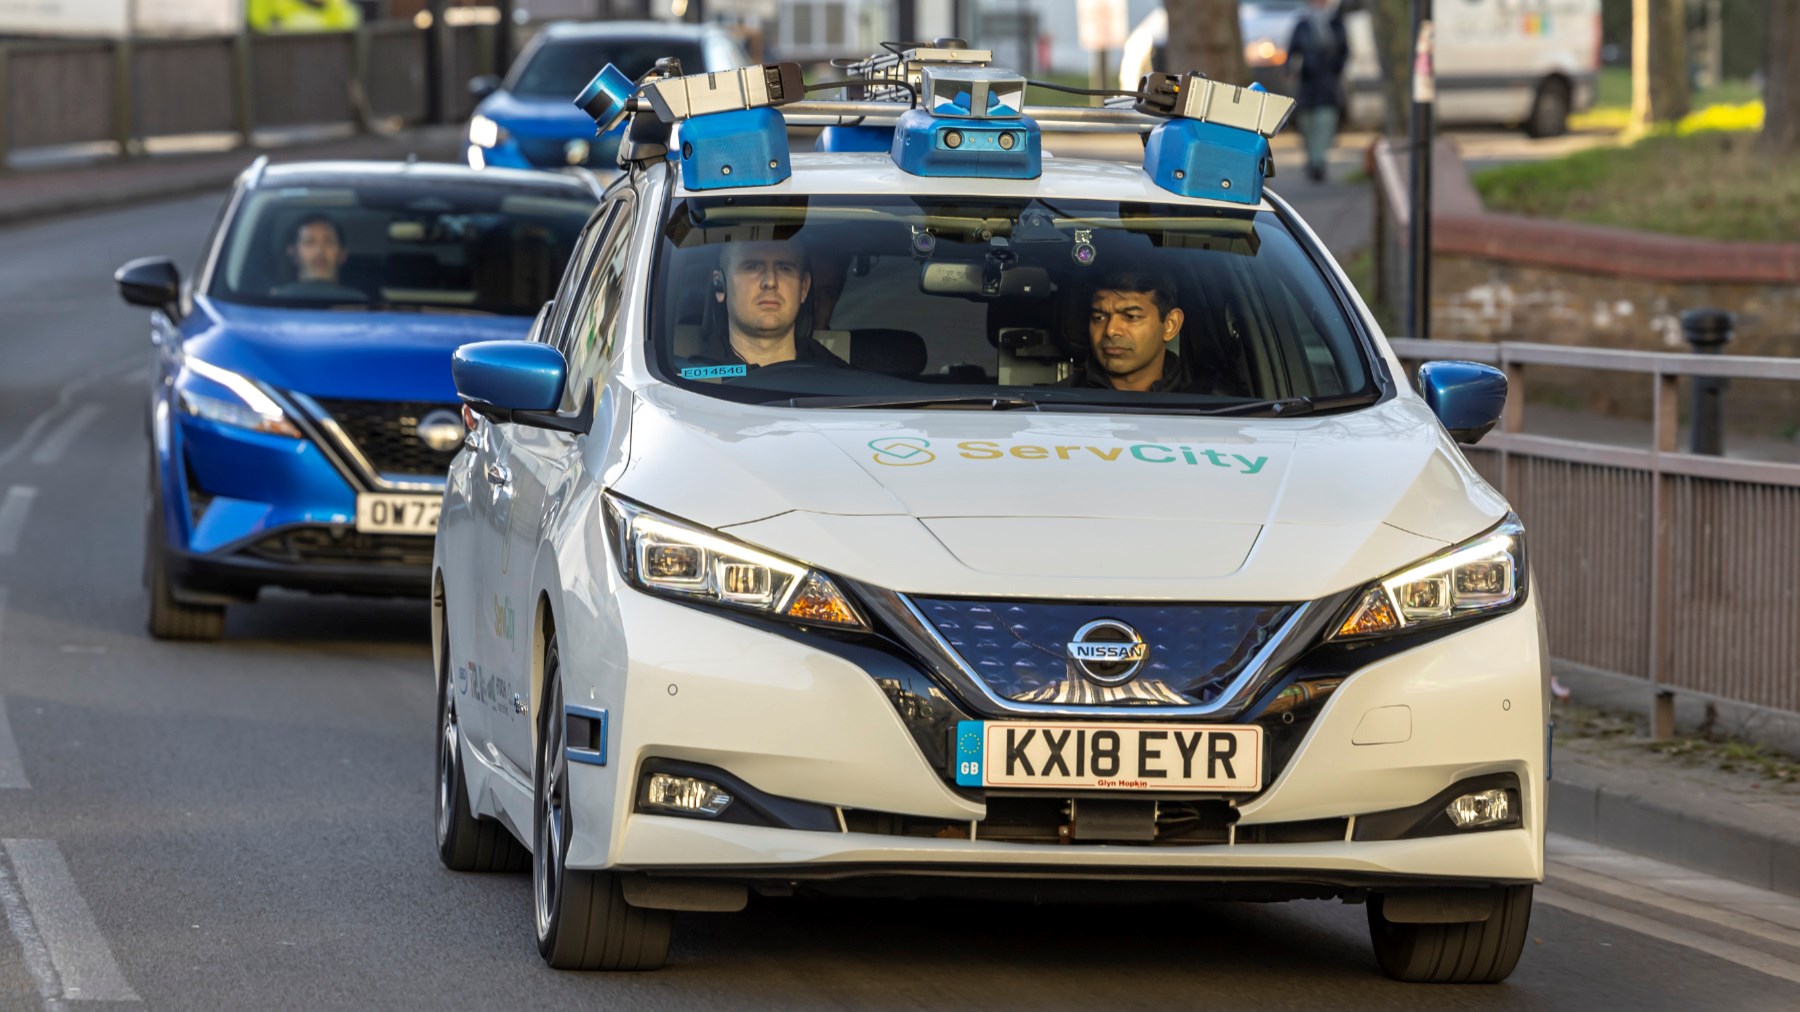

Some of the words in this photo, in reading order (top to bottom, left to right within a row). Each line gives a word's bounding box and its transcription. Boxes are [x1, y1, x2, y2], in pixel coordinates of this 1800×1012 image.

[684, 366, 743, 377] E014546
[956, 440, 1269, 474] ServCity
[1077, 646, 1142, 657] NISSAN
[1005, 728, 1120, 777] KX18
[1138, 730, 1237, 779] EYR
[960, 761, 979, 775] GB
[1097, 779, 1116, 787] Glyn
[1118, 779, 1147, 788] Hopkin
